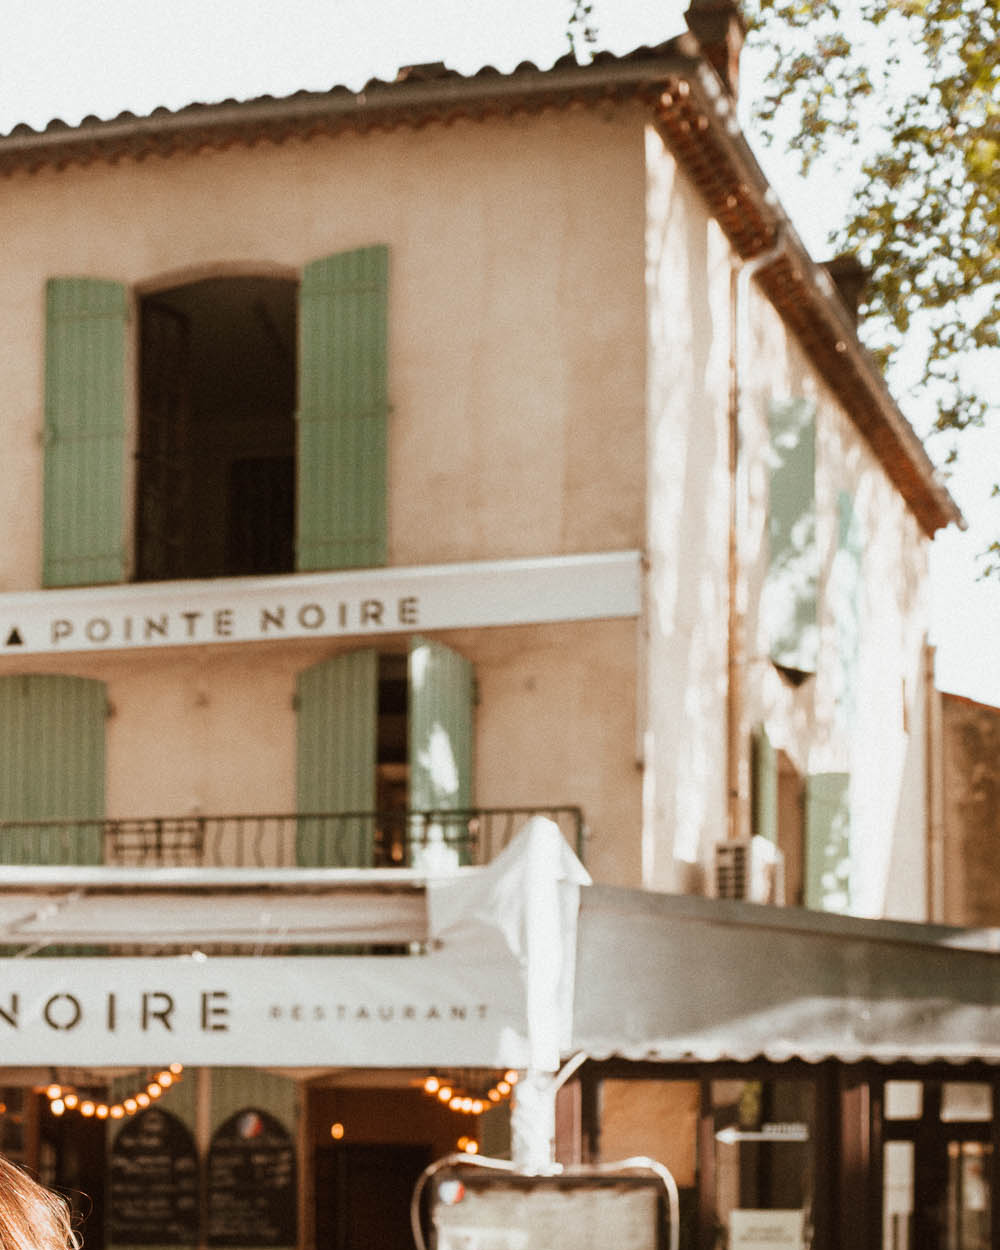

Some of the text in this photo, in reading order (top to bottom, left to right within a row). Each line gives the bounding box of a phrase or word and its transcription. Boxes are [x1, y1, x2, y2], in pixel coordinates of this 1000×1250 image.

[50, 609, 234, 645] POINTE
[260, 597, 421, 633] NOIRE
[268, 1003, 488, 1021] RESTAURANT
